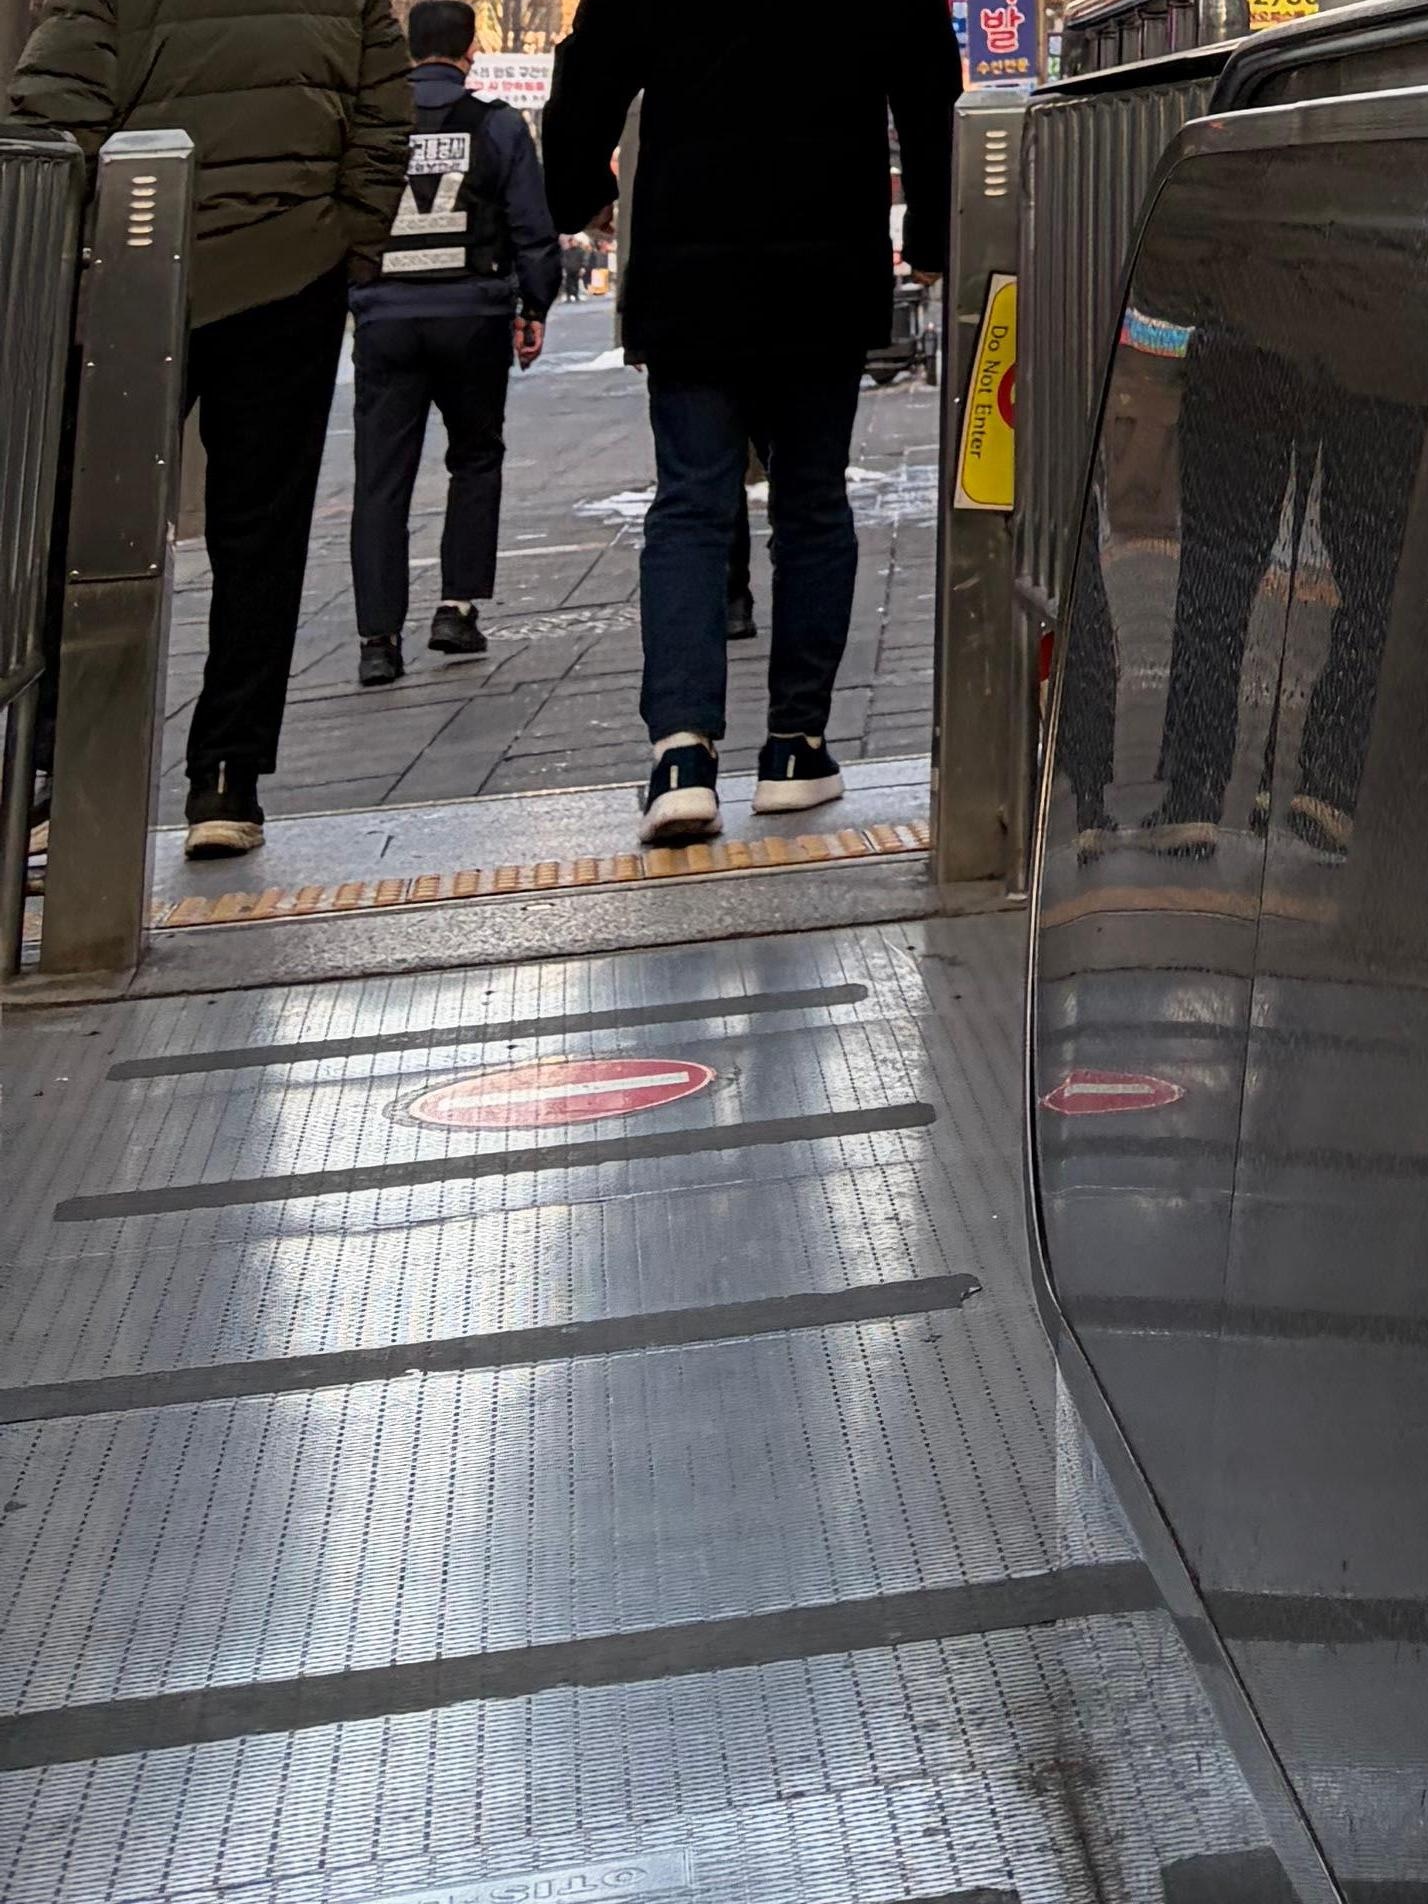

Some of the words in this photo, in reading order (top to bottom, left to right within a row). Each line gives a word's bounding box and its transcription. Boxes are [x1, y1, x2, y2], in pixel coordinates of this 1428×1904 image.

[987, 324, 1008, 352] Do
[978, 359, 1001, 394] Not
[970, 403, 993, 460] Enter
